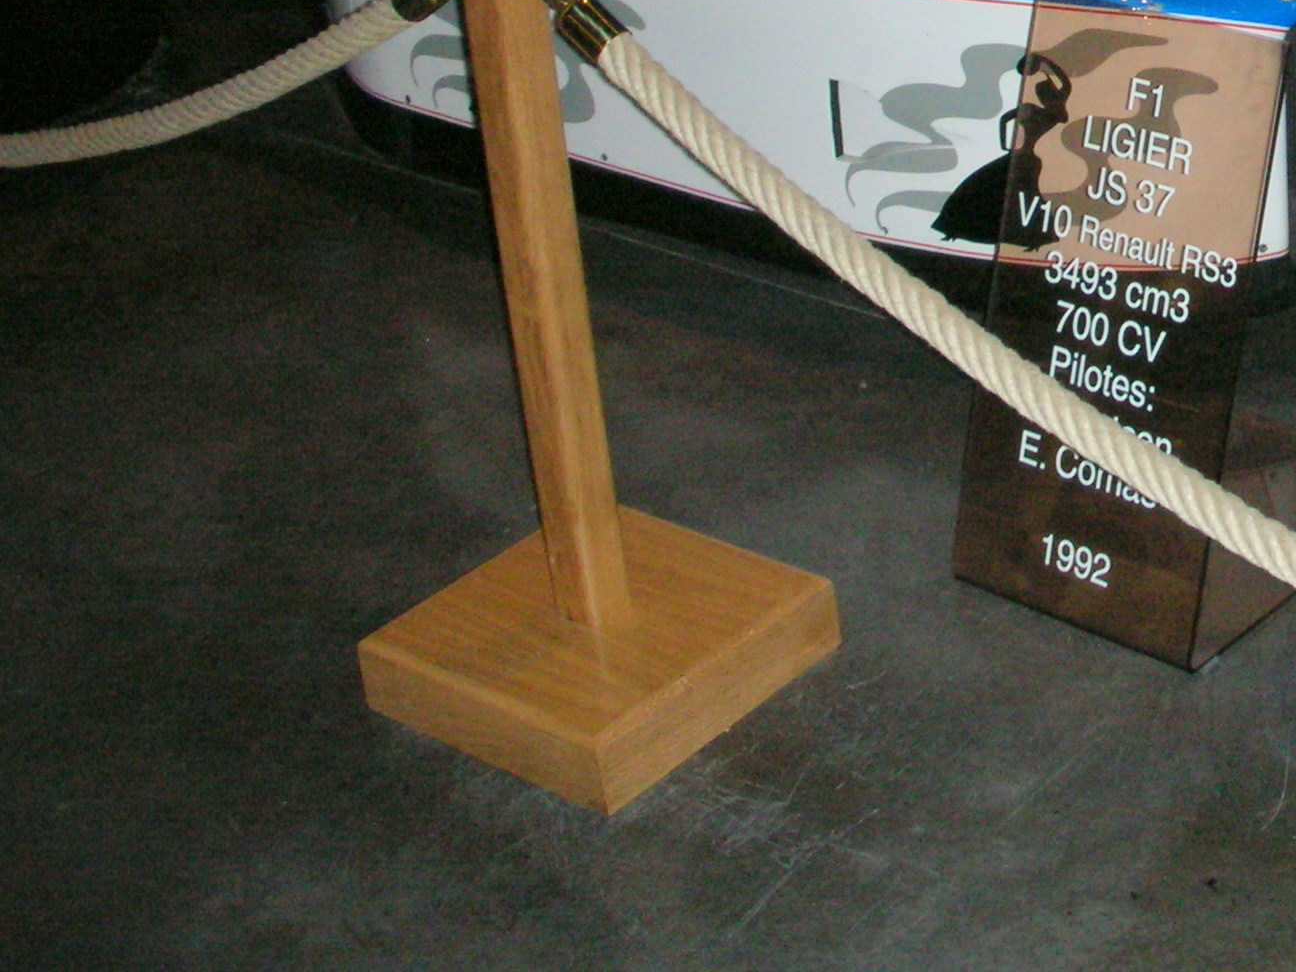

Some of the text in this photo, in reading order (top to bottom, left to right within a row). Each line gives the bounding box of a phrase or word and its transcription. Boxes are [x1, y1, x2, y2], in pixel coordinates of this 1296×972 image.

[1127, 77, 1165, 119] F1
[1082, 122, 1194, 175] LIGIER
[1086, 168, 1175, 218] JS 37
[1017, 191, 1238, 288] V10 Renault RS3
[1044, 250, 1191, 324] 3493 cm3
[1055, 299, 1168, 364] 700 CV
[1049, 345, 1156, 412] Pilotes:
[1018, 429, 1046, 471] E.
[1042, 533, 1112, 589] 1992
